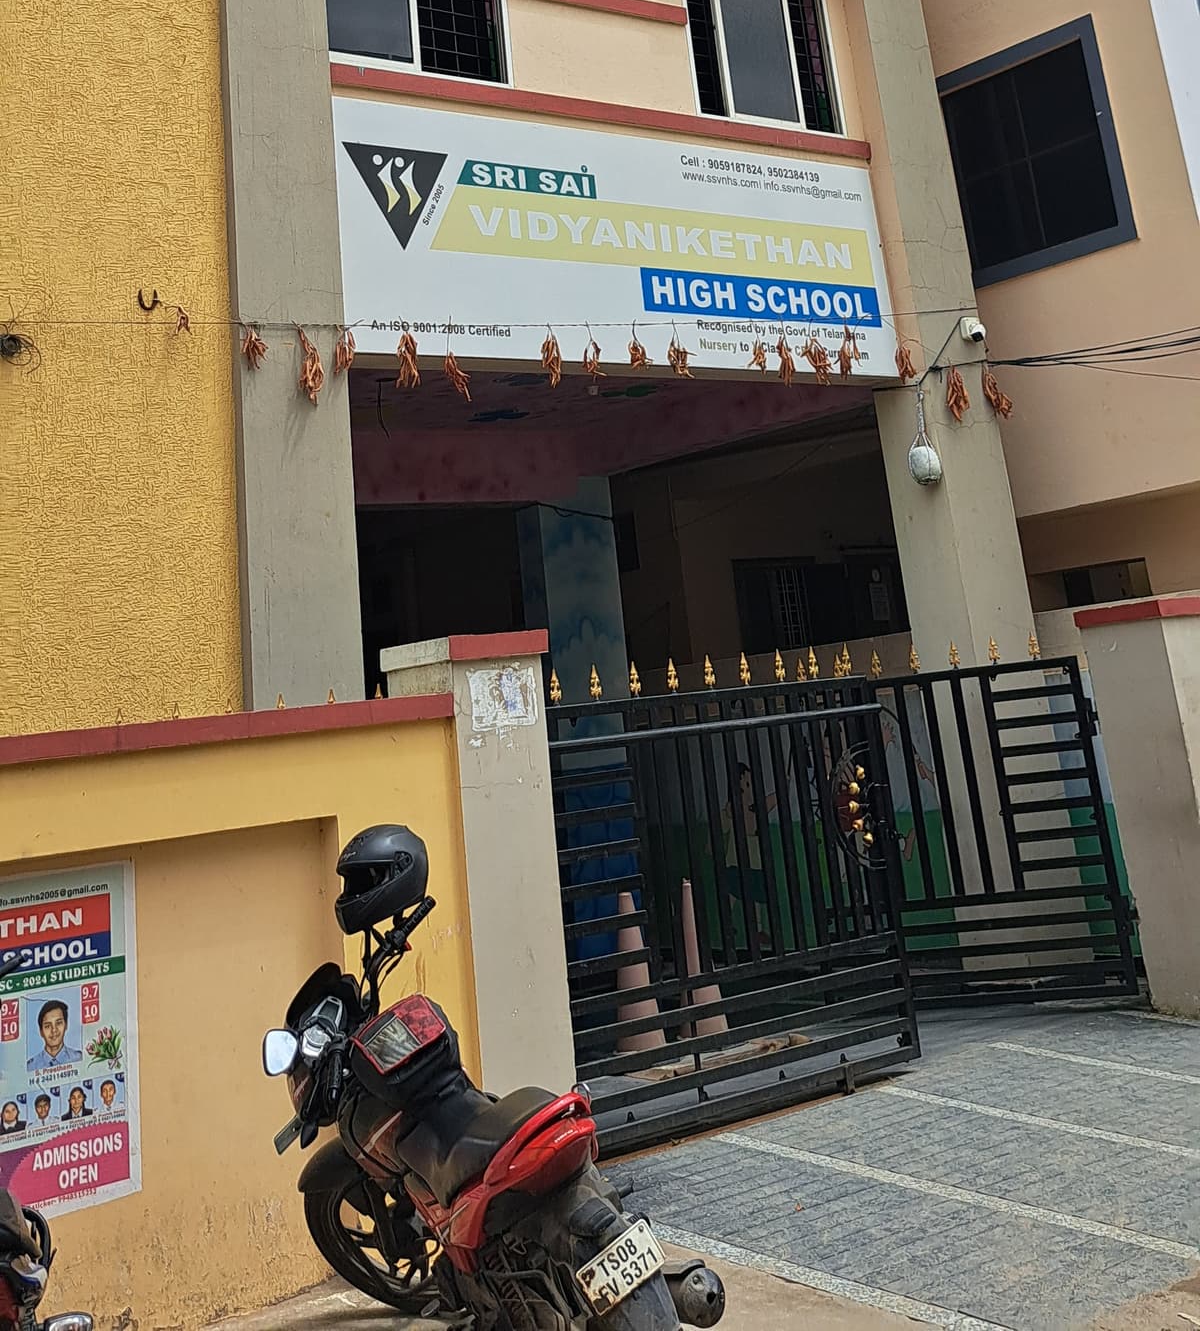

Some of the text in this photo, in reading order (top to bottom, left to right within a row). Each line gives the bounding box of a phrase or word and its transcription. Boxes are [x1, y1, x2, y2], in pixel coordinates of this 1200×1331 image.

[471, 163, 526, 190] SRI
[680, 154, 699, 168] Cell
[767, 167, 820, 183] 9502384139
[422, 182, 445, 226] Since 2005
[763, 179, 862, 202] info.ssvnhs@gmail.com
[468, 204, 852, 269] VIDYANIKETHAN
[651, 275, 872, 320] HIGH SCHOOL
[371, 319, 511, 338] An ISO 9001:2008 Certified
[697, 319, 752, 335] Recognised
[755, 322, 766, 337] by
[811, 327, 820, 338] of
[822, 328, 867, 341] Telanna
[699, 337, 737, 354] Nursery
[739, 341, 749, 352] to
[0, 907, 83, 939] THAN
[23, 975, 48, 988] 2024
[50, 961, 110, 982] STUDENTS
[81, 984, 99, 1000] 9.7
[1, 1001, 18, 1017] 9.7
[84, 1004, 98, 1019] 10
[3, 1021, 17, 1036] 10
[32, 1132, 123, 1171] ADMISSIONS
[59, 1163, 99, 1190] OPEN
[597, 1238, 638, 1277] TS08
[621, 1246, 658, 1287] 5371
